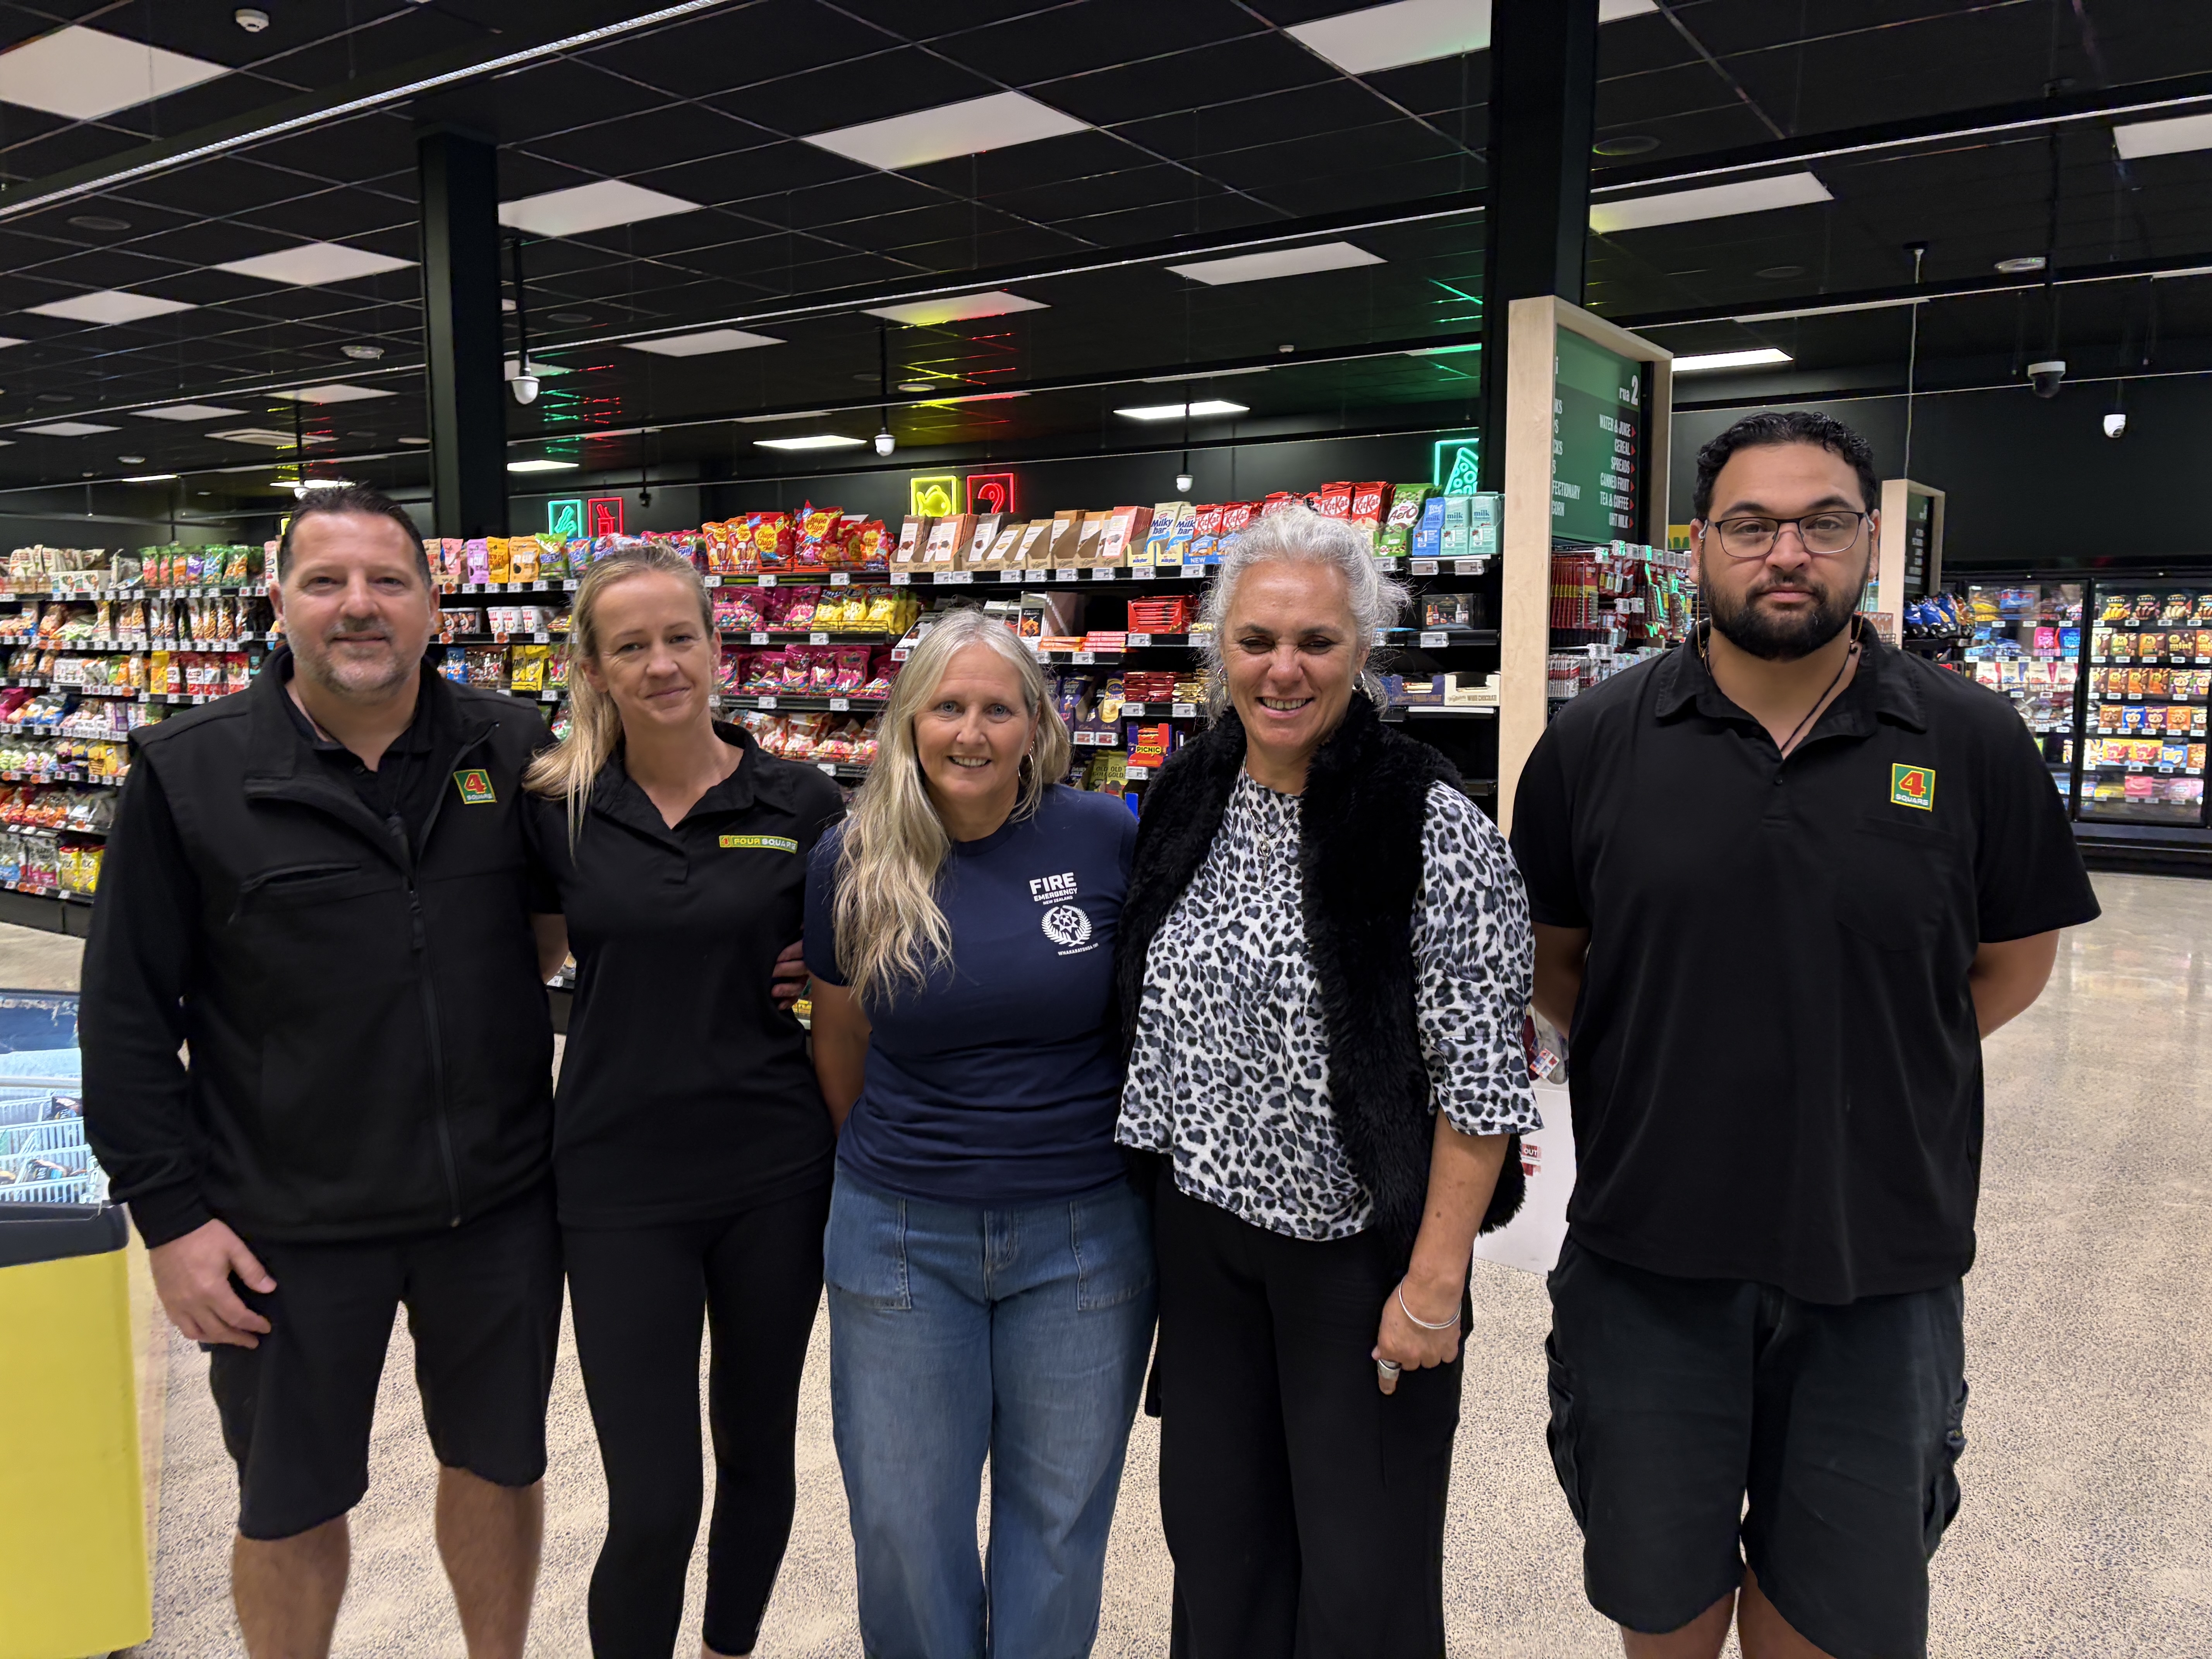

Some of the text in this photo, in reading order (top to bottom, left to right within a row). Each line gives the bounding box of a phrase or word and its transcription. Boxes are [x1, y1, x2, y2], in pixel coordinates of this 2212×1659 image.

[1620, 375, 1638, 405] rua 2
[1599, 414, 1631, 437] WATER & JUICE
[1614, 438, 1630, 455] CEREAL
[1611, 456, 1630, 474] SPREADS
[1600, 472, 1630, 492] CANNED FRUIT
[1323, 496, 1348, 515] KitKat
[1354, 495, 1379, 514] KitKat
[1609, 493, 1613, 507] &
[1614, 495, 1629, 510] COFFEE
[1151, 518, 1173, 528] Milky
[1176, 520, 1196, 528] Milk
[1196, 512, 1219, 530] KitKat
[1609, 512, 1629, 529] UHT MILK
[756, 538, 774, 548] Chups
[757, 531, 774, 539] Chupa
[464, 773, 487, 794] 4
[1898, 770, 1926, 798] 4
[1896, 793, 1929, 806] SQUARE
[721, 837, 729, 846] 4
[762, 839, 796, 850] SQUARE
[1029, 872, 1077, 895] FIRE
[1034, 888, 1077, 902] EMERGENCY
